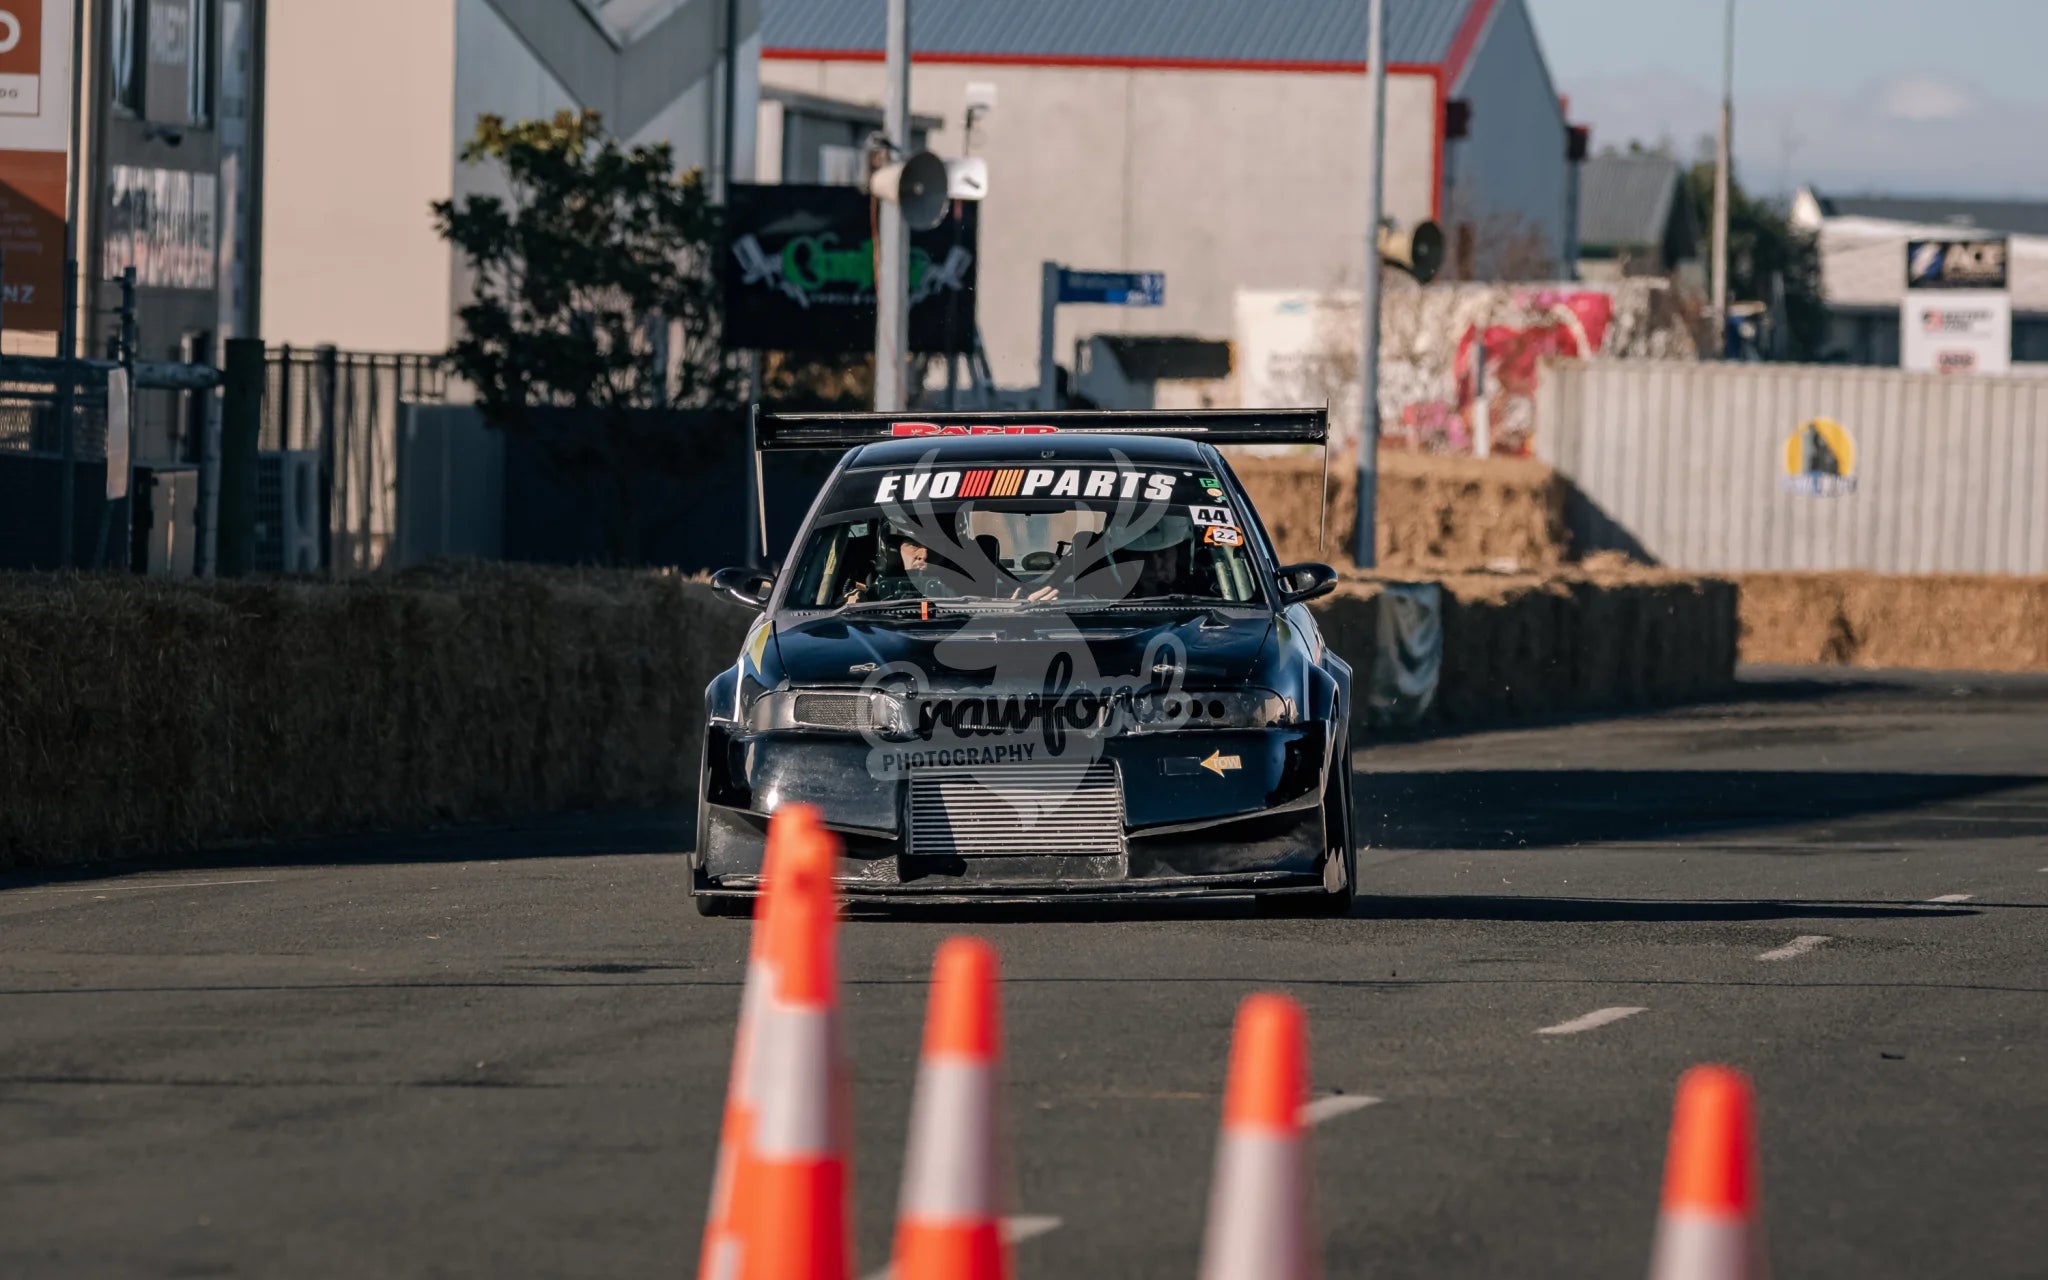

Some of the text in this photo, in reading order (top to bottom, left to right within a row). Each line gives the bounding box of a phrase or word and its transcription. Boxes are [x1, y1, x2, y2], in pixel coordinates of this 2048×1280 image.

[874, 469, 1176, 503] EVO PARTS
[1198, 508, 1229, 524] 44
[1212, 757, 1240, 769] TOW
